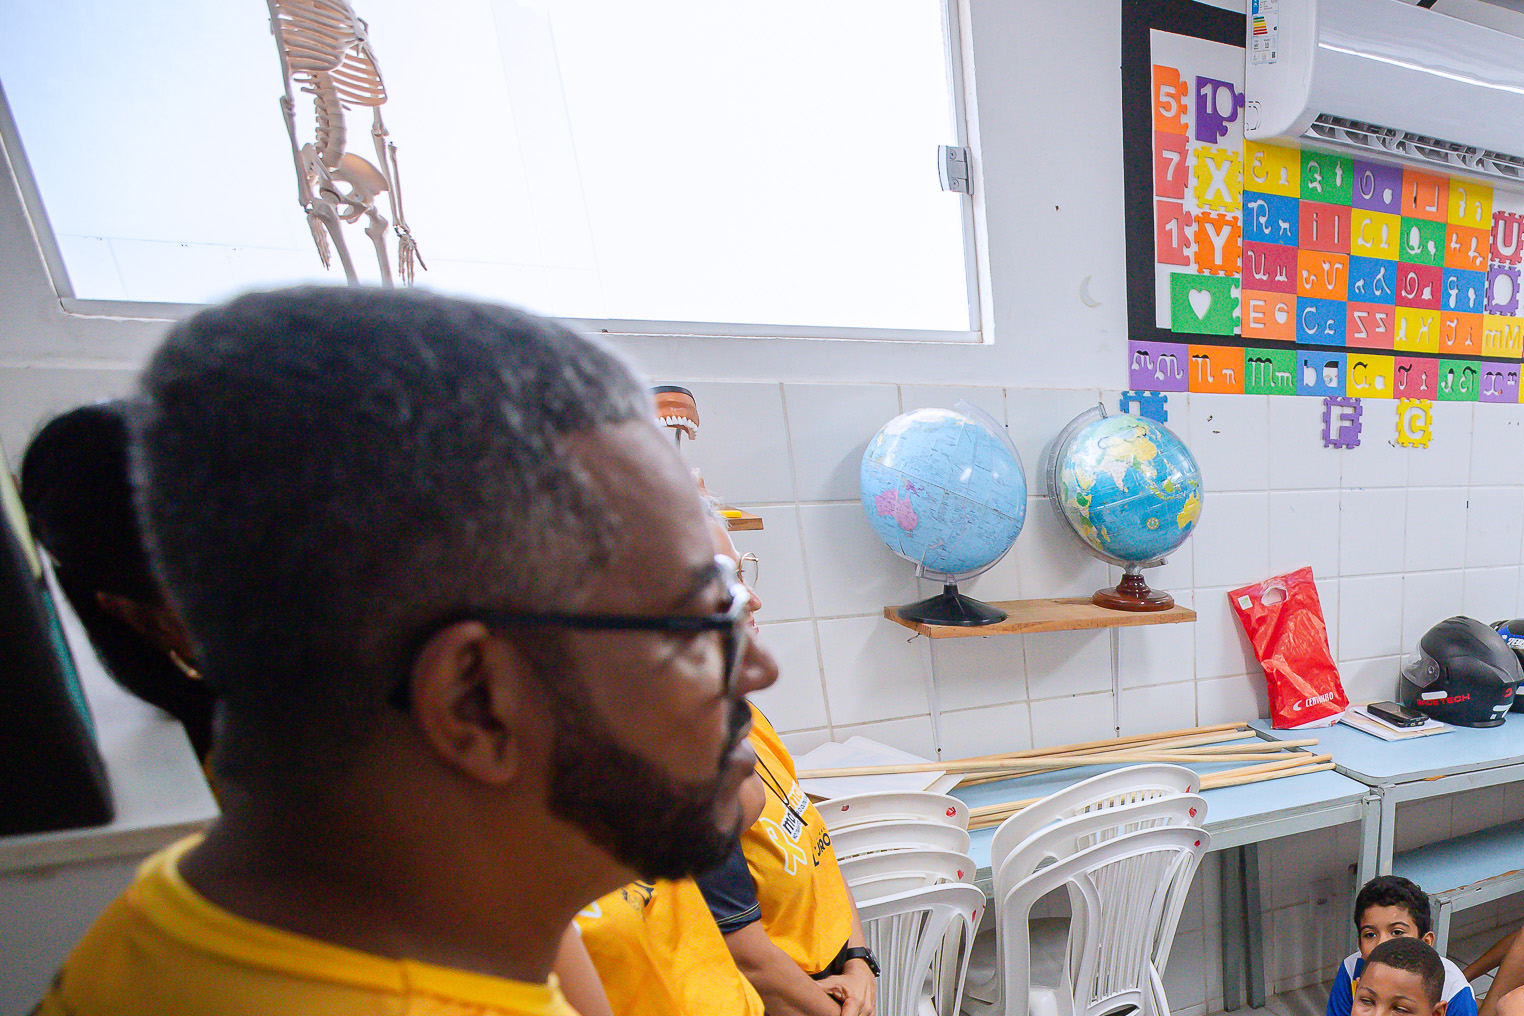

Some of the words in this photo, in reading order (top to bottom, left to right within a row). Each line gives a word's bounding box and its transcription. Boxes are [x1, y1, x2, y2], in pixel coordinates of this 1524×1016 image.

[1159, 84, 1177, 117] 5
[1200, 83, 1233, 118] 10
[1162, 150, 1181, 181] 7
[1204, 157, 1233, 202] X
[1204, 222, 1233, 265] Y
[1497, 219, 1519, 256] U
[1330, 405, 1356, 440] F
[1440, 693, 1470, 705] TECH
